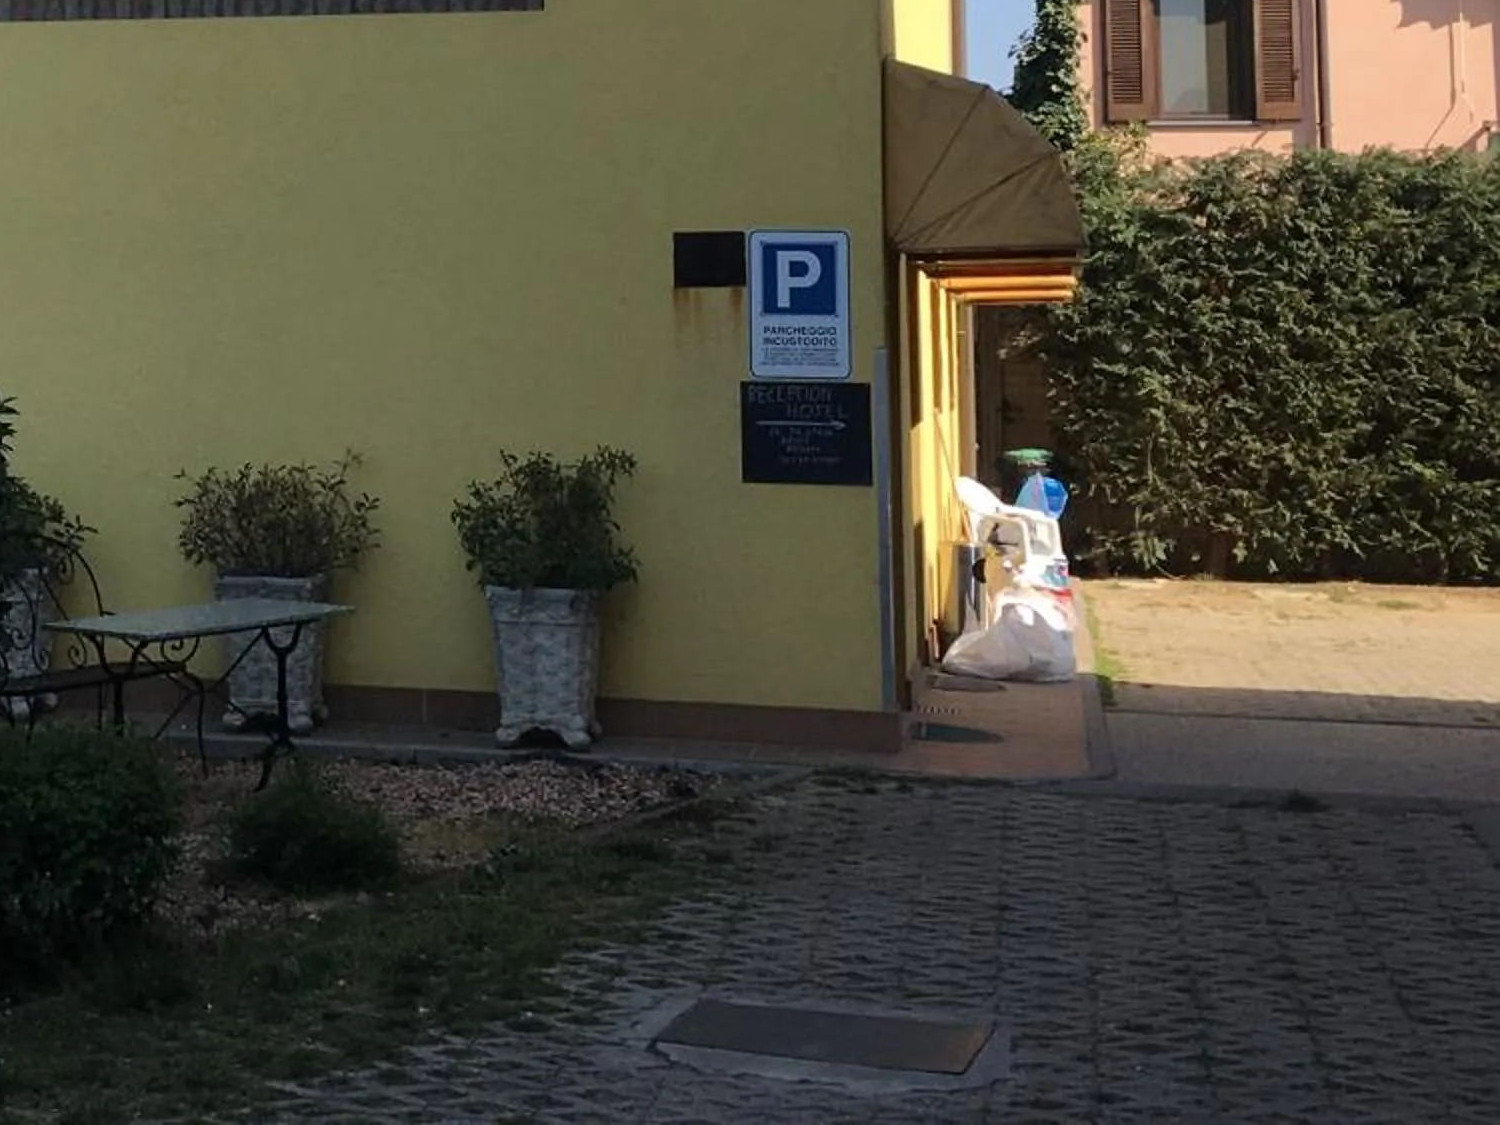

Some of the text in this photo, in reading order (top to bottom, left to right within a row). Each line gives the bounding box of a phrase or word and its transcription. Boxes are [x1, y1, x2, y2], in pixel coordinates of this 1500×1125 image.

[776, 250, 822, 308] P
[763, 325, 837, 336] PARCHEGGIO
[763, 336, 837, 346] INCUSTODITO
[747, 385, 833, 404] RECEPTION
[786, 404, 848, 419] HOTEL
